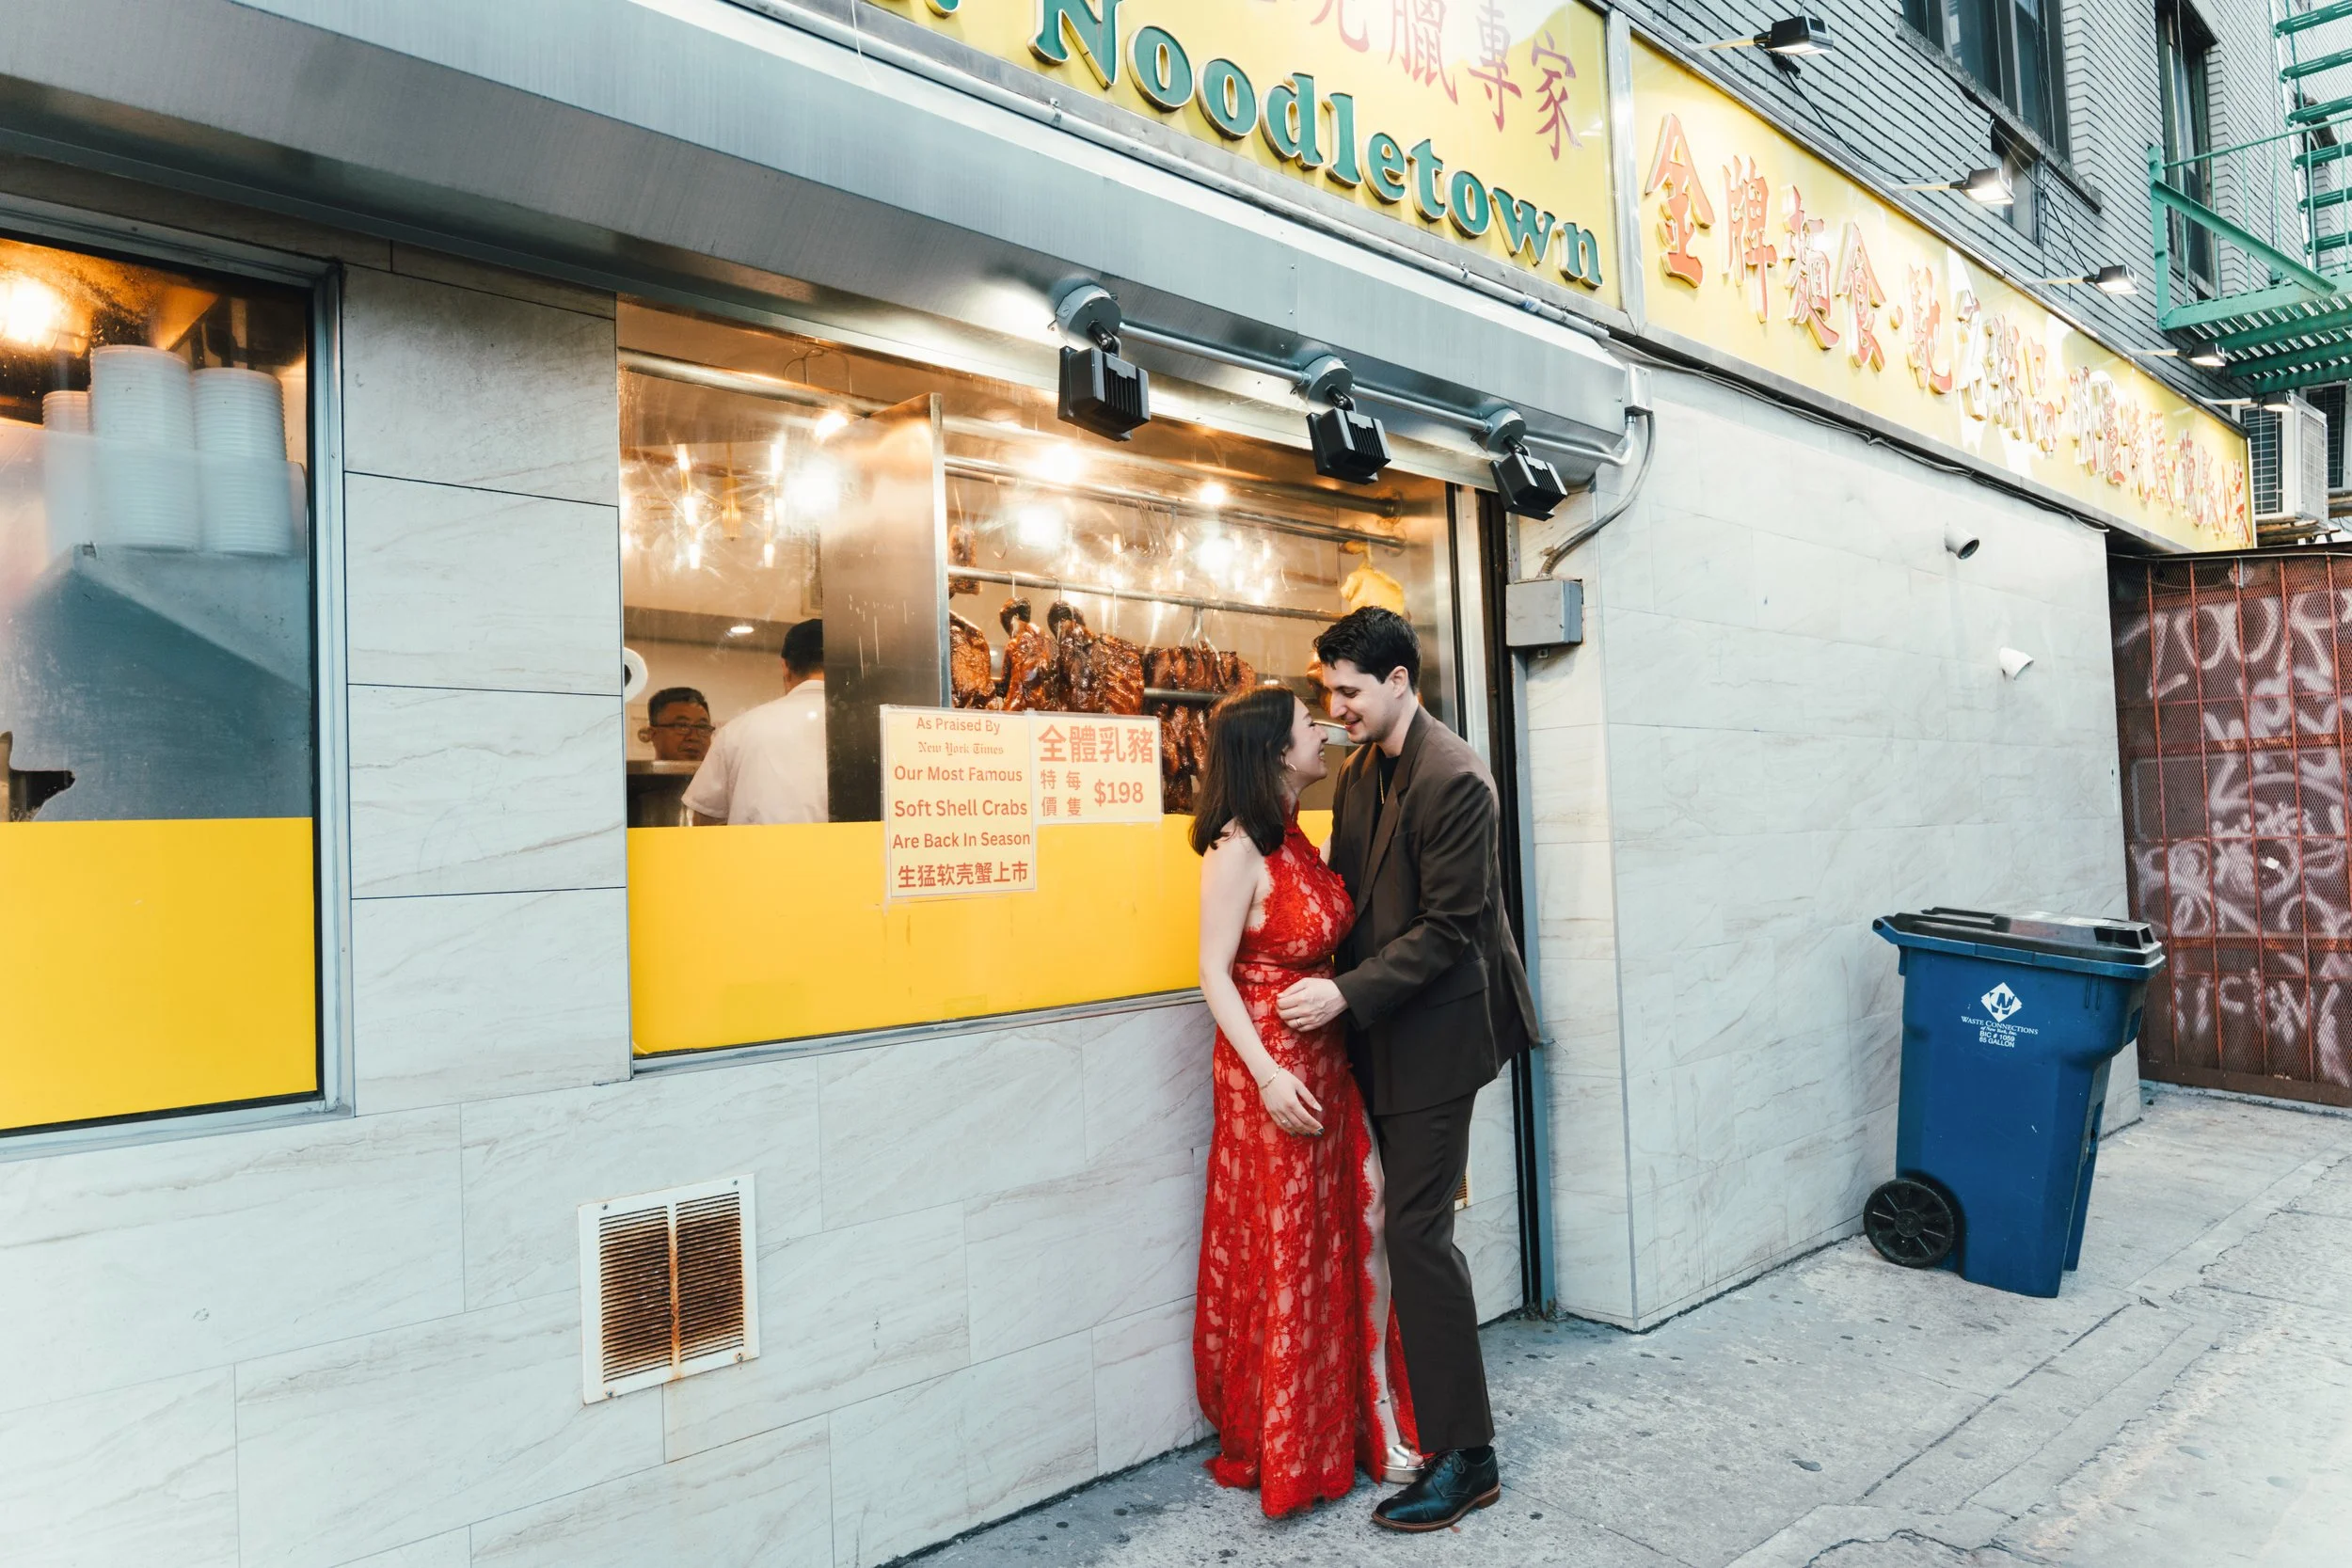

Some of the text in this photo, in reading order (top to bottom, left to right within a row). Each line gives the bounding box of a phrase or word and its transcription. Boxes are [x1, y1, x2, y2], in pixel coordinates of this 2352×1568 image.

[1027, 0, 1604, 289] Noodletown
[916, 717, 1001, 736] As Praised By
[918, 741, 1004, 756] New York Times
[1038, 723, 1154, 764] 全體乳豬
[894, 766, 1023, 783] Our Most Famous
[1094, 778, 1145, 807] $198
[894, 800, 1028, 817] Soft Shell Crabs
[892, 832, 1031, 849] Are Back In Season
[898, 860, 1028, 889] 生猛软壳蟹上市
[1961, 1015, 2039, 1036] WASTE CONNECTIONS
[1979, 1030, 1993, 1038] BIC
[1999, 1033, 2015, 1042] 1059
[1988, 1037, 2015, 1048] GALLON
